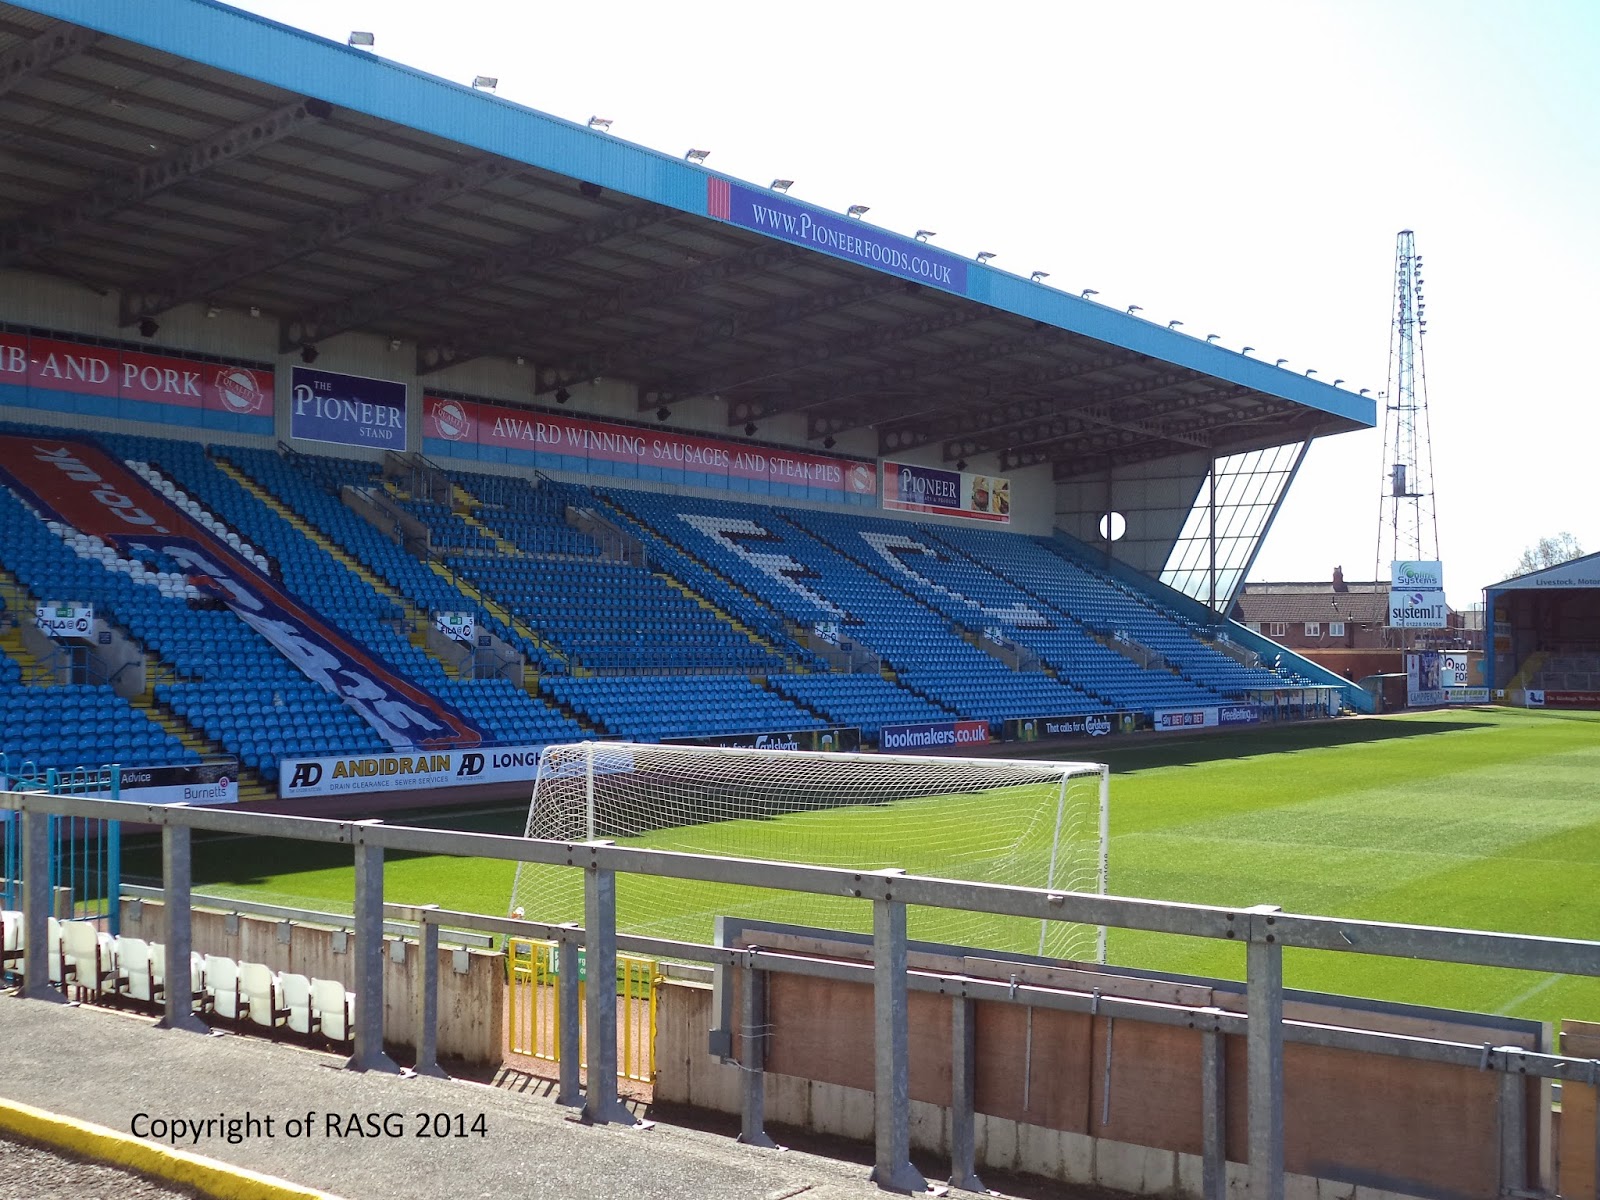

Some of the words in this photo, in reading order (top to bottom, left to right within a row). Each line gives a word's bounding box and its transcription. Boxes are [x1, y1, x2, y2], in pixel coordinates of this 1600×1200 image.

[122, 363, 201, 397] PORK
[314, 380, 332, 391] THE
[294, 384, 402, 429] PIONEER
[359, 426, 393, 440] STAND
[492, 417, 562, 444] AWARD
[565, 427, 646, 456] WINNING
[653, 440, 730, 468] SAUSAGES
[734, 452, 765, 472] AND
[769, 457, 813, 480] STEAK
[814, 463, 841, 483] PIES
[901, 468, 957, 499] PIONEER
[1397, 575, 1438, 585] Systems
[1535, 579, 1577, 587] Livestock,
[38, 609, 44, 617] 3
[85, 610, 91, 618] 4
[1046, 722, 1059, 733] That
[1060, 721, 1073, 733] calls
[1073, 721, 1081, 732] for
[1085, 715, 1111, 735] Carlsberg
[1172, 714, 1183, 725] BET
[1193, 713, 1203, 724] BET
[884, 725, 985, 748] bookmakers.co.uk
[331, 754, 451, 779] ANDIDRAIN
[456, 753, 485, 776] AD
[121, 772, 151, 784] Advice
[288, 762, 323, 788] AD
[330, 783, 351, 791] DRAIN
[352, 780, 390, 790] CLEARANCE
[395, 778, 417, 786] SEWER
[418, 775, 449, 785] SERVICES
[184, 785, 227, 800] Burnetts
